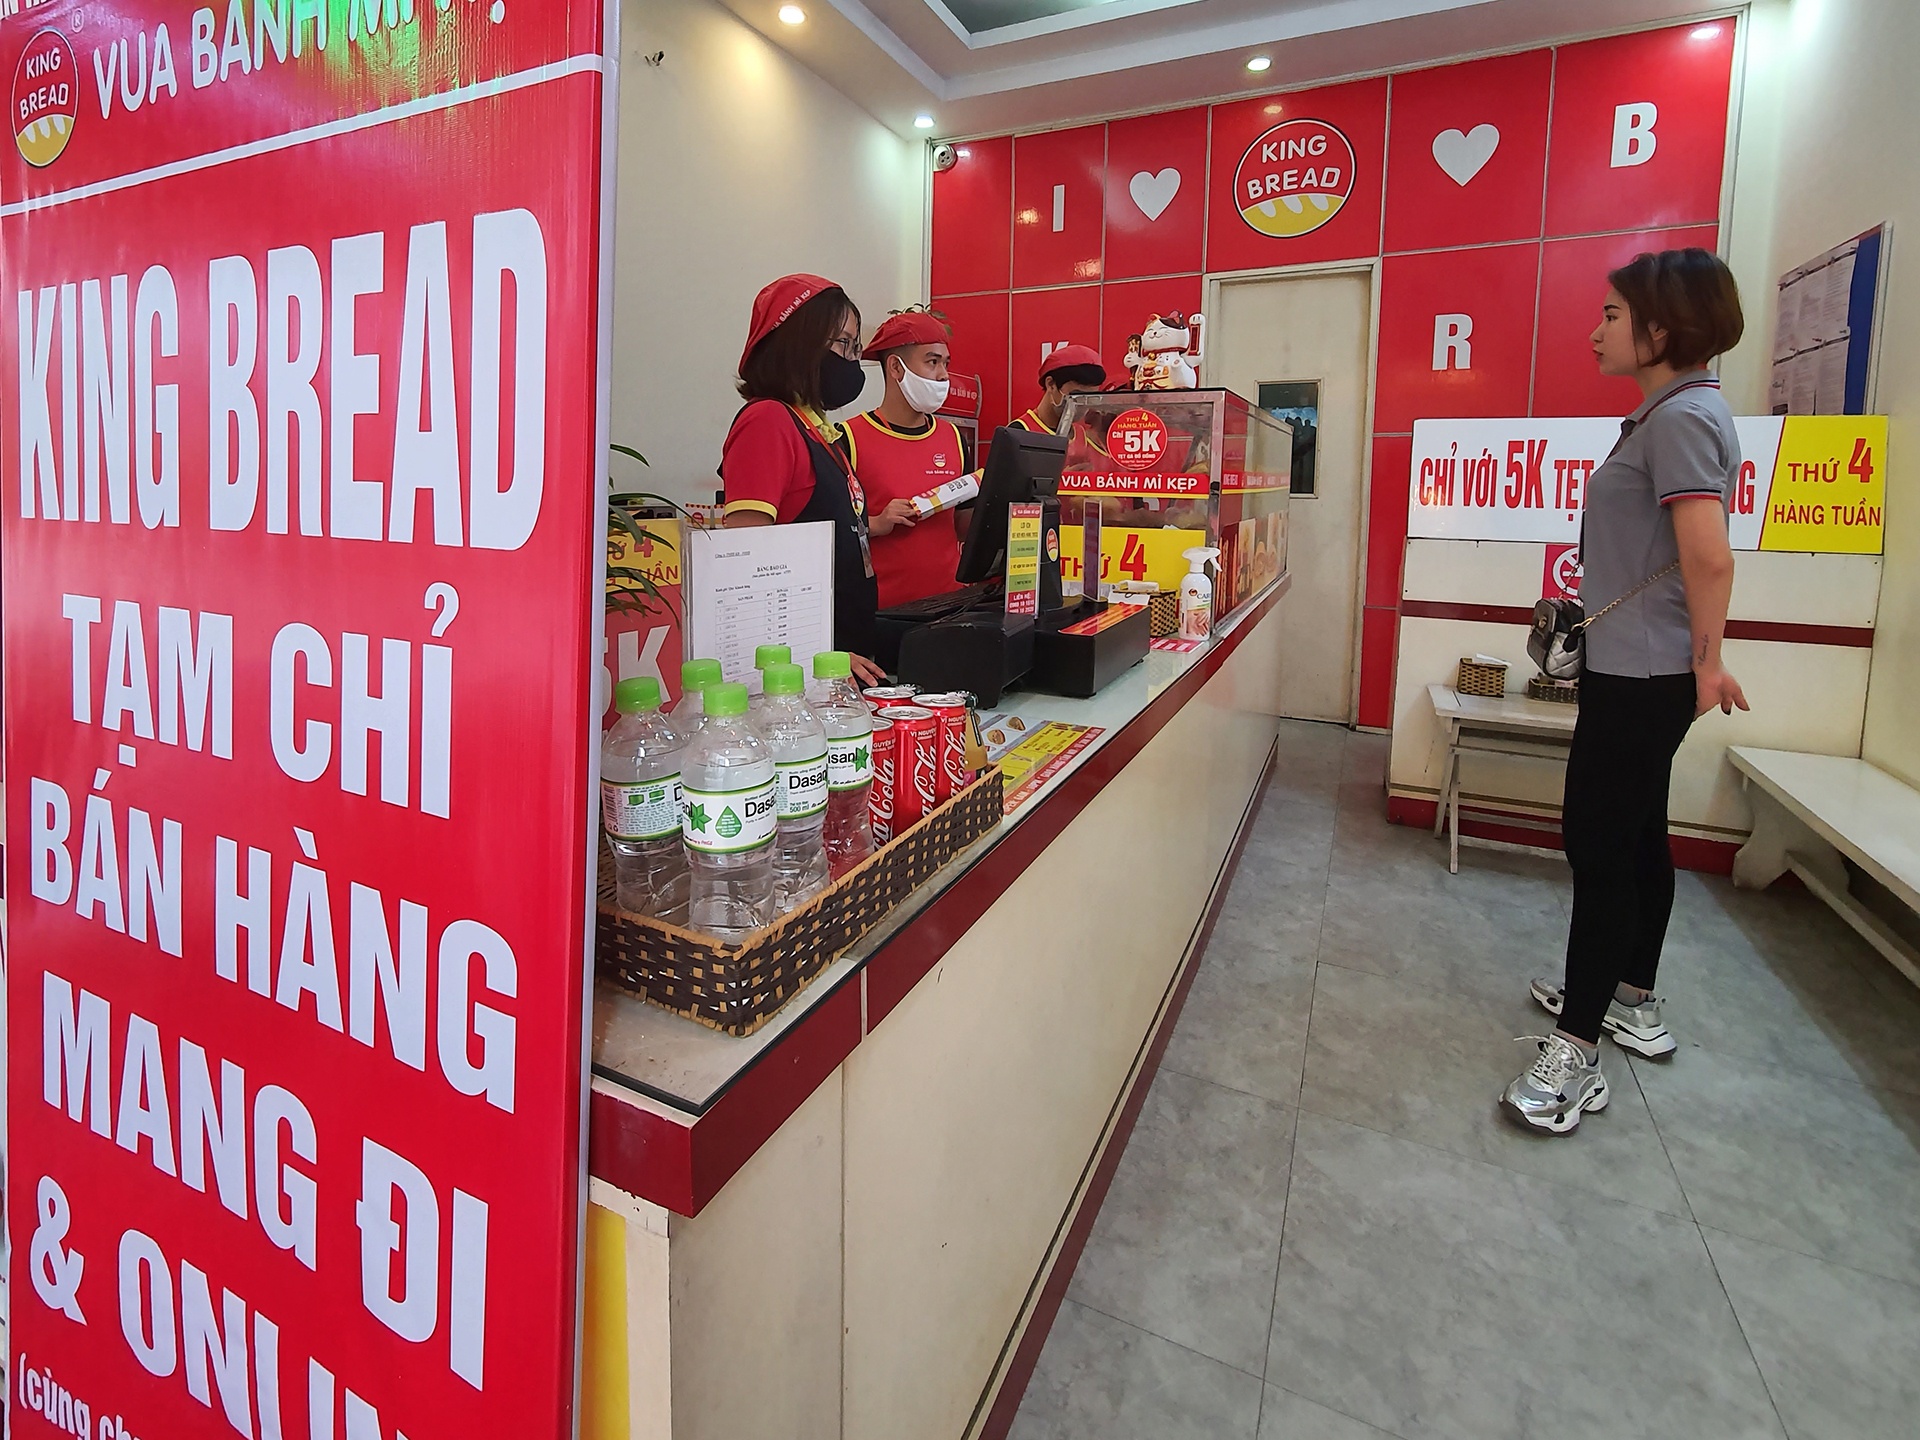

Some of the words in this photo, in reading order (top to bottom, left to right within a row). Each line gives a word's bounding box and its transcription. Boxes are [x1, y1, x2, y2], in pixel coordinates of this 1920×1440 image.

[26, 47, 61, 79] KING
[93, 22, 178, 119] VUA
[20, 83, 69, 120] BREAD
[1261, 134, 1327, 163] KING
[1610, 102, 1658, 168] B
[1246, 166, 1341, 199] BREAD
[1431, 313, 1474, 371] R
[18, 265, 180, 530] KING
[207, 208, 548, 551] BREAD
[1124, 430, 1161, 452] 5K
[1141, 412, 1149, 421] 4
[1061, 475, 1091, 488] VUA
[1096, 472, 1138, 489] BÁNH
[1143, 474, 1162, 490] MÌ
[1167, 478, 1198, 493] KẸP
[1419, 441, 1457, 507] CHỈ
[1463, 448, 1498, 508] VỚI
[1504, 439, 1548, 509] 5K
[1787, 457, 1840, 483] THỨ
[1848, 438, 1874, 483] 4
[1773, 499, 1825, 525] HÀNG
[1831, 498, 1881, 527] TUẦN
[1120, 534, 1147, 581] 4
[602, 624, 671, 717] K
[62, 593, 234, 767] TẠM
[270, 582, 460, 820] CHỈ
[30, 767, 183, 958] BÁN
[215, 826, 519, 1114] HÀNG
[43, 970, 318, 1272] MANG
[356, 1136, 489, 1392] ĐI
[30, 1175, 88, 1326] &
